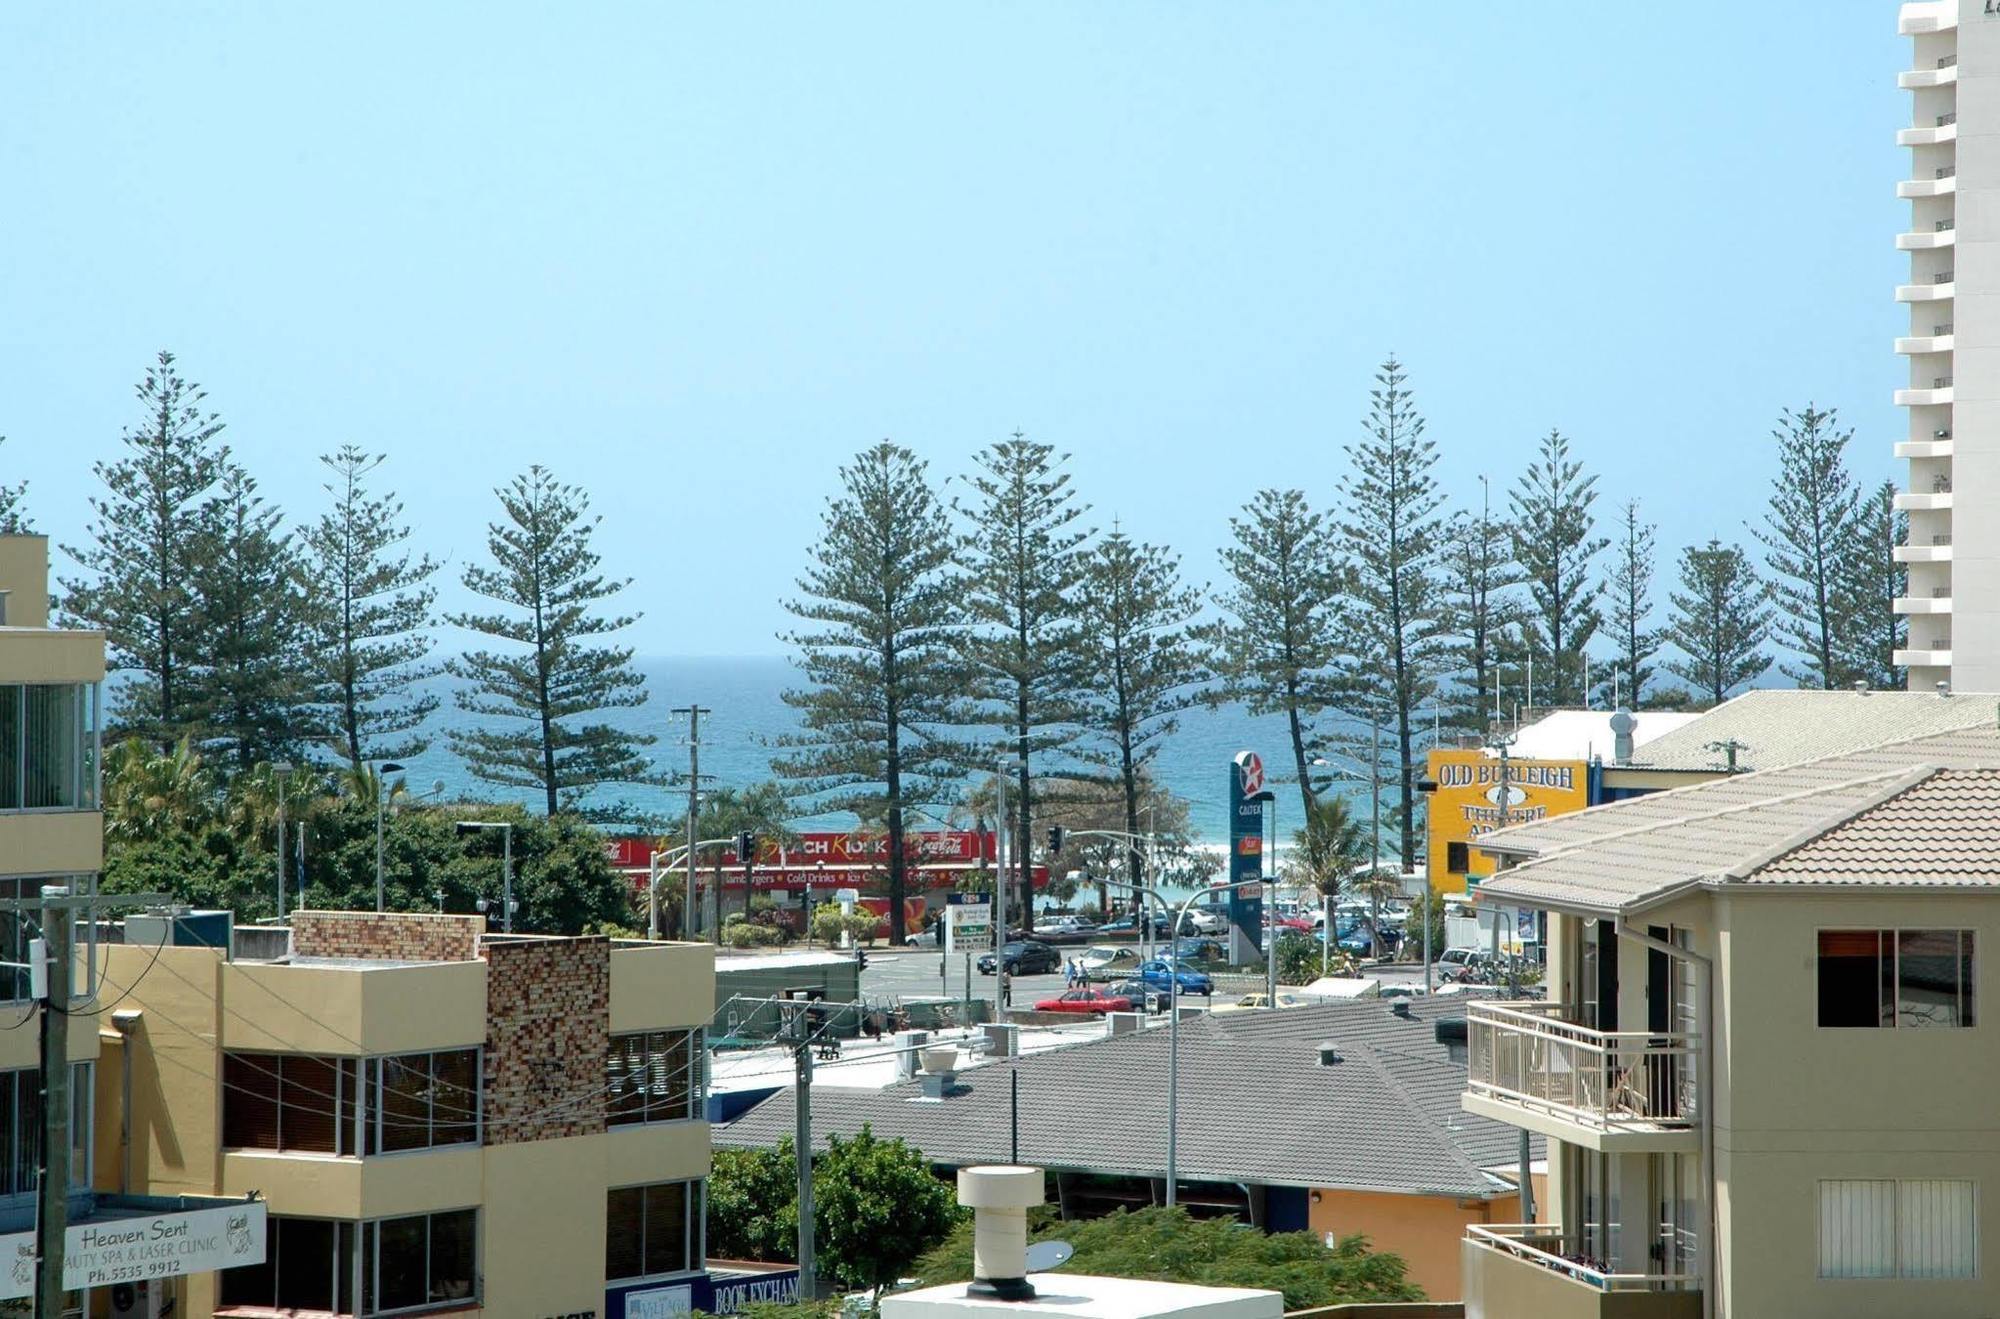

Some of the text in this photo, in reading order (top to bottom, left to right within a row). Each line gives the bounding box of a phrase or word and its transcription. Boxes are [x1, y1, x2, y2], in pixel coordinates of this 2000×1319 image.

[1439, 764, 1474, 787] OLD
[1239, 805, 1261, 816] CALTEX
[786, 873, 836, 884] Cold Drinks
[81, 1219, 189, 1250] Heaven Sent
[64, 1235, 219, 1270] AUTY SPA & LASER CLINIC
[88, 1260, 181, 1283] Ph.5535 9912
[714, 1285, 747, 1315] BOOK
